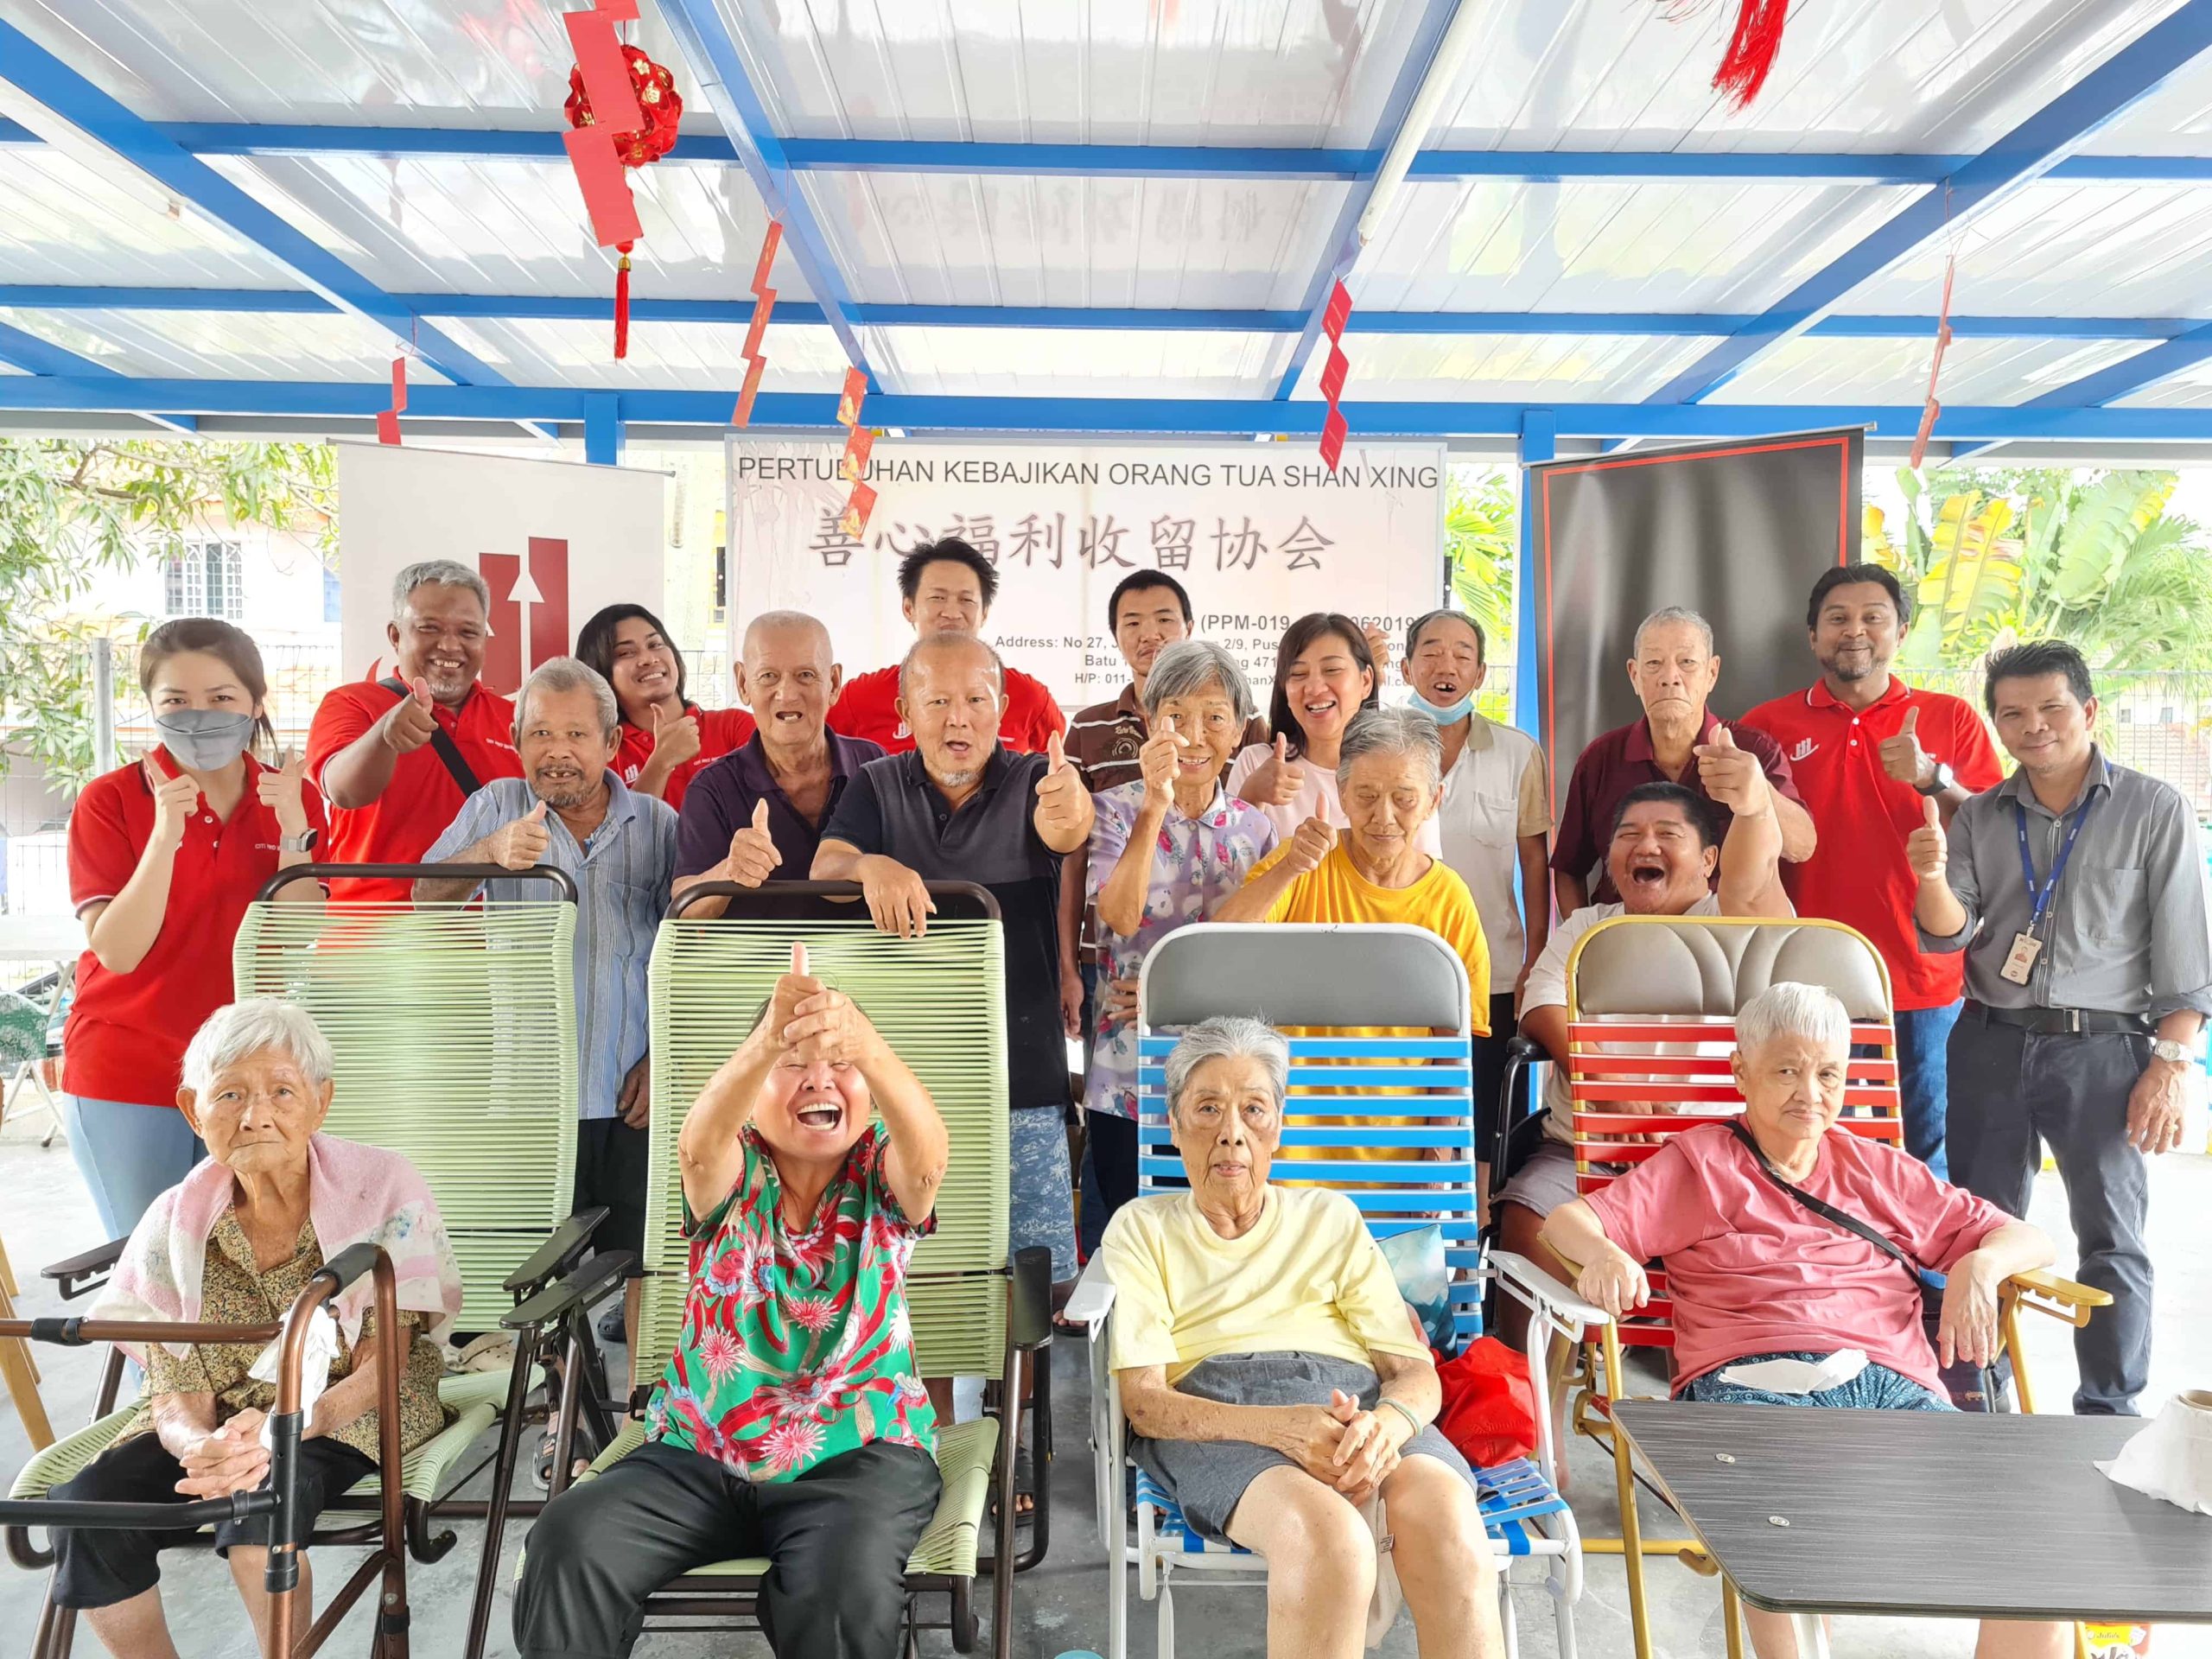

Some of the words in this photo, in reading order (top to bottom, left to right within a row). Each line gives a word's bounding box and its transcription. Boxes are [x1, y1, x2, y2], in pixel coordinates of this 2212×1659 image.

[944, 461, 1098, 485] KEBAJIKAN
[1109, 463, 1211, 486] ORANG
[1220, 465, 1276, 486] TUA
[1283, 465, 1360, 487] SHAN
[1370, 467, 1438, 488] XING
[995, 636, 1058, 648] Address:
[1064, 637, 1082, 648] No
[1087, 637, 1106, 650] 27,
[1224, 639, 1248, 651] 2/9,
[1253, 639, 1279, 650] Pus
[1085, 655, 1116, 666] Batu
[1254, 657, 1276, 668] 471
[1075, 673, 1101, 683] H/P:
[1105, 673, 1131, 683] 011-
